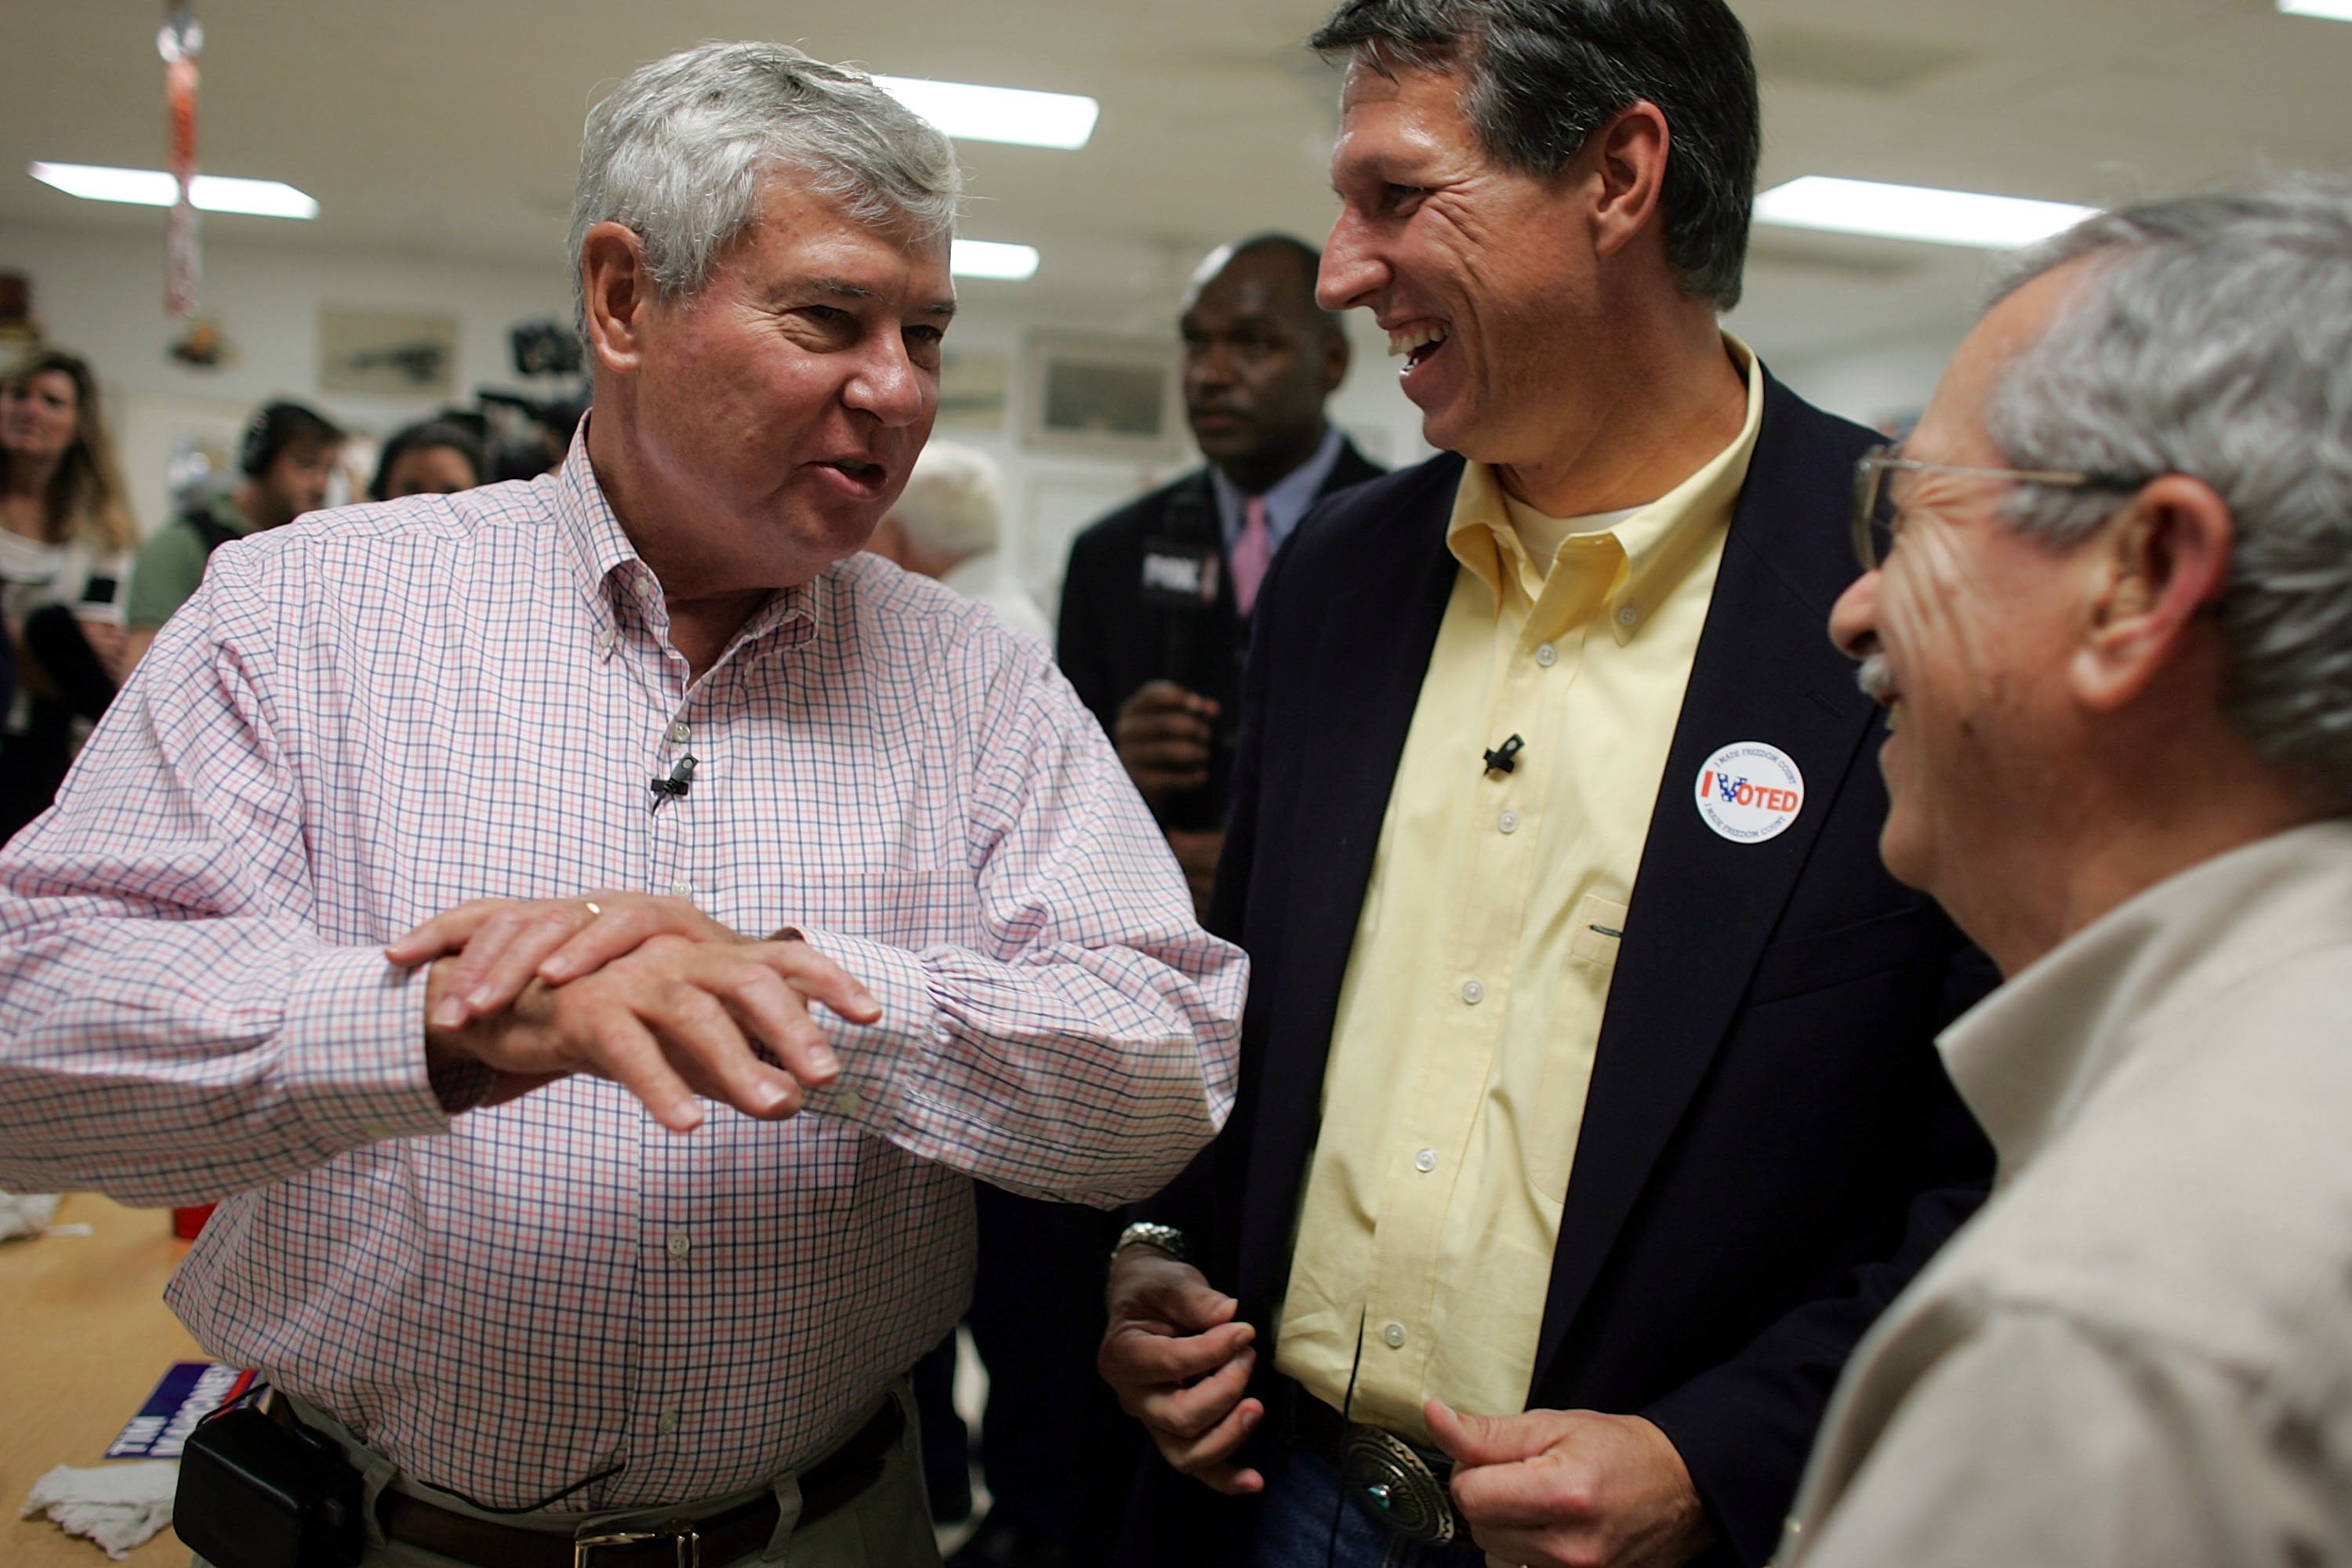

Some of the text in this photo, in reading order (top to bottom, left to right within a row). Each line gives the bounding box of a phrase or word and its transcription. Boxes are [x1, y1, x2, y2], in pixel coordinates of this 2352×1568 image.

[1741, 748, 1779, 763] FREEDOM
[1777, 760, 1796, 785] COUNT
[1701, 771, 1798, 812] I VOTED
[1761, 815, 1787, 835] COUNT
[108, 1415, 169, 1456] TIM
